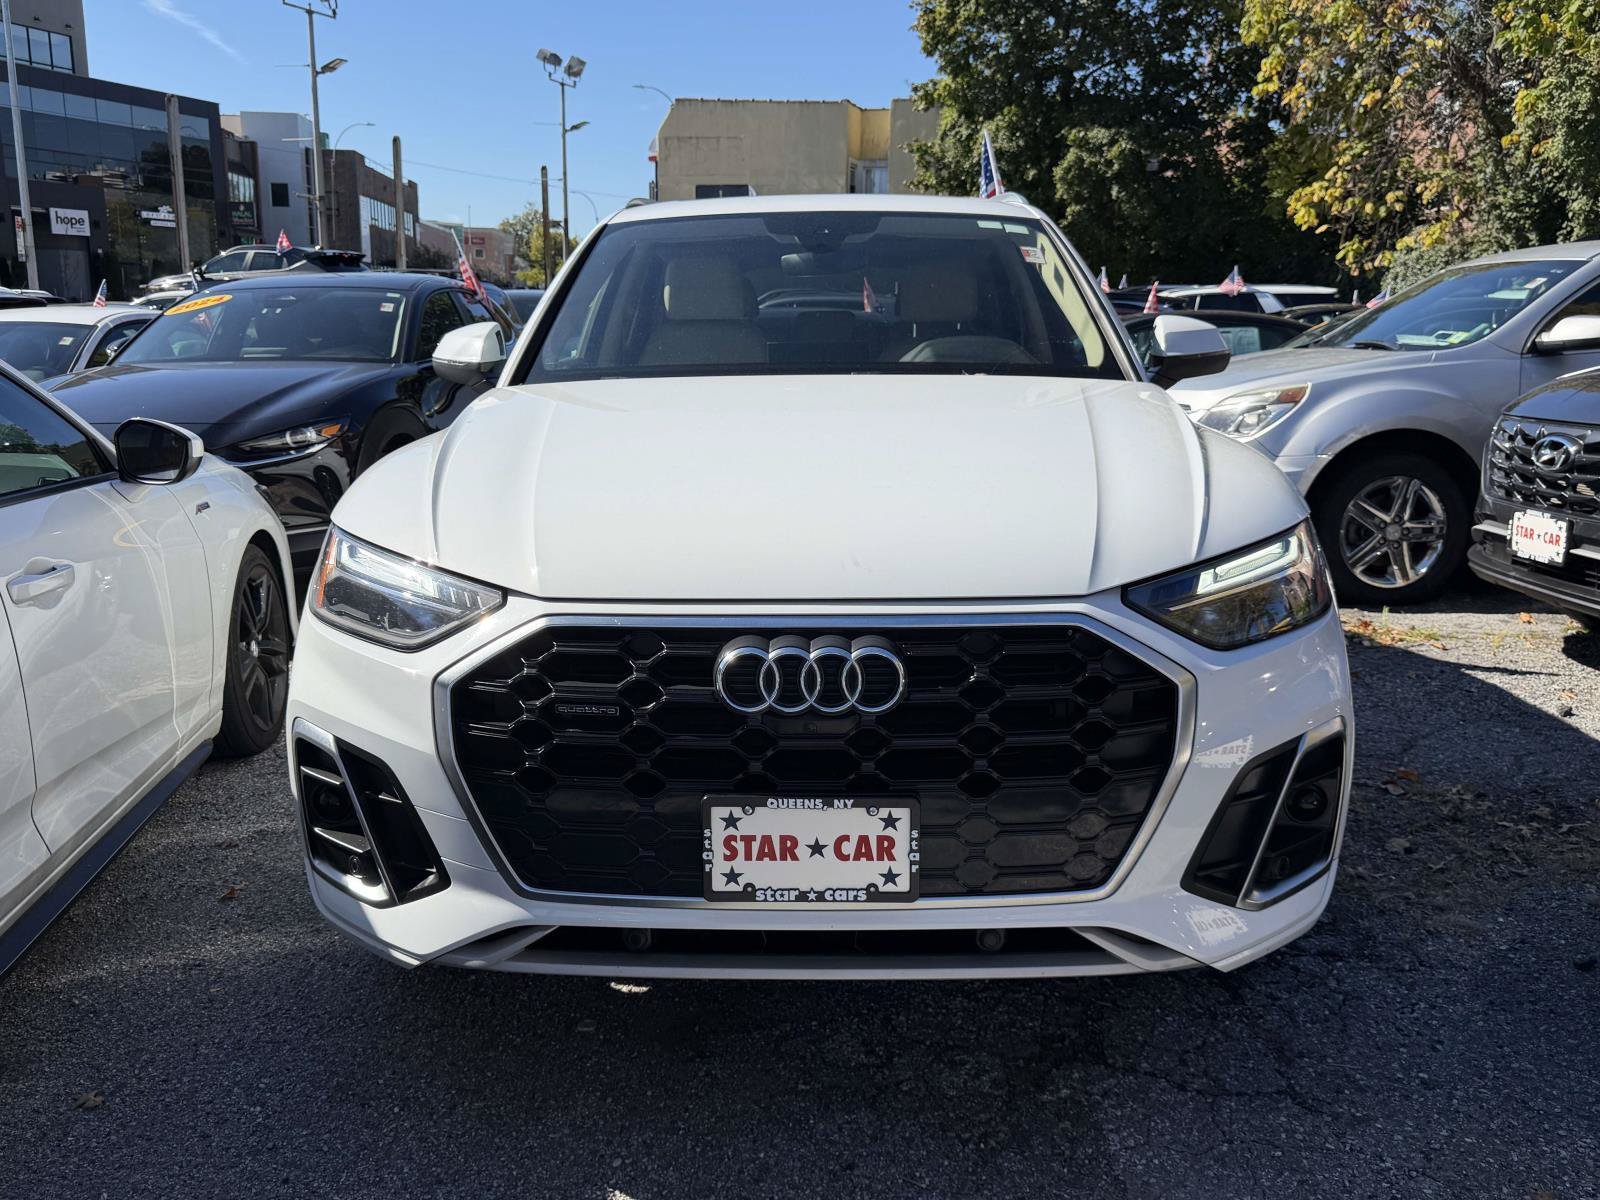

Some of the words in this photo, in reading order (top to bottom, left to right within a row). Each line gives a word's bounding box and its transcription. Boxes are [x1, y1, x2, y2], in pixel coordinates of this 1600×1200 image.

[55, 210, 85, 228] hope
[1515, 524, 1535, 541] STAR
[1543, 531, 1561, 547] CAR
[557, 706, 616, 714] quattro
[766, 798, 828, 811] QUEENS,
[833, 799, 854, 809] NY
[722, 834, 800, 862] STAR
[833, 834, 896, 862] CAR
[755, 888, 800, 901] star
[824, 888, 868, 901] cars
